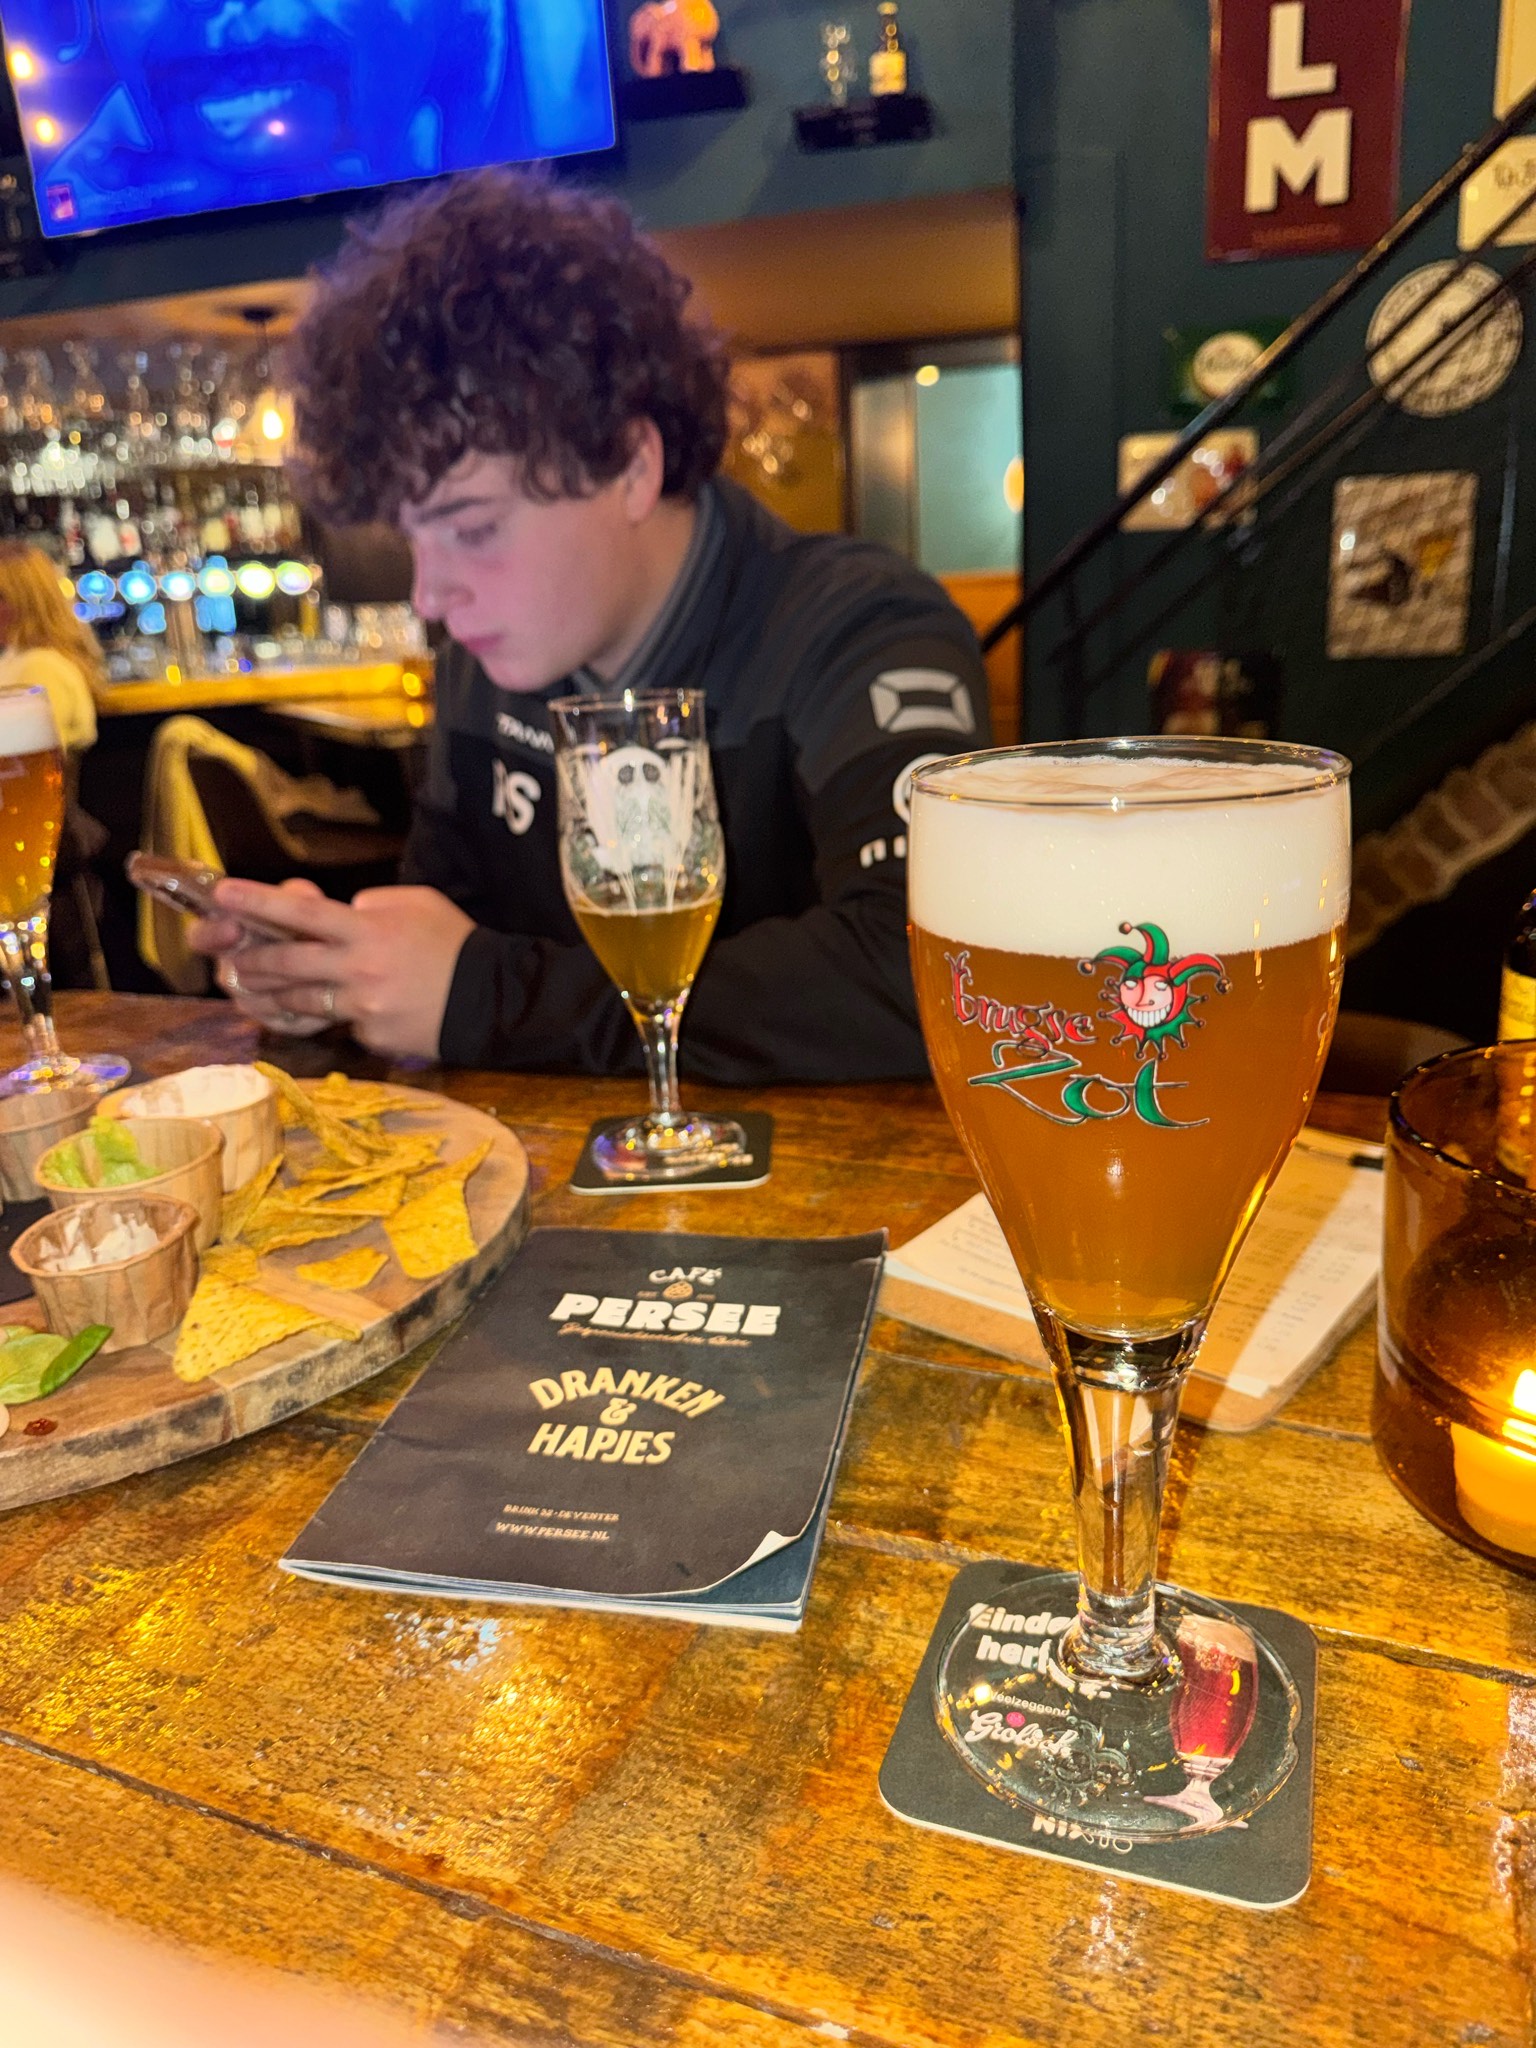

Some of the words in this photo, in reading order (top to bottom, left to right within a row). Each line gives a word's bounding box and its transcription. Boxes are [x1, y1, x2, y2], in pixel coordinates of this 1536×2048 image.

[967, 1039, 1210, 1128] Zot
[549, 1293, 781, 1335] PERSEE
[528, 1366, 726, 1419] DRANKEN
[600, 1397, 637, 1426] &
[527, 1423, 675, 1464] HAPJES
